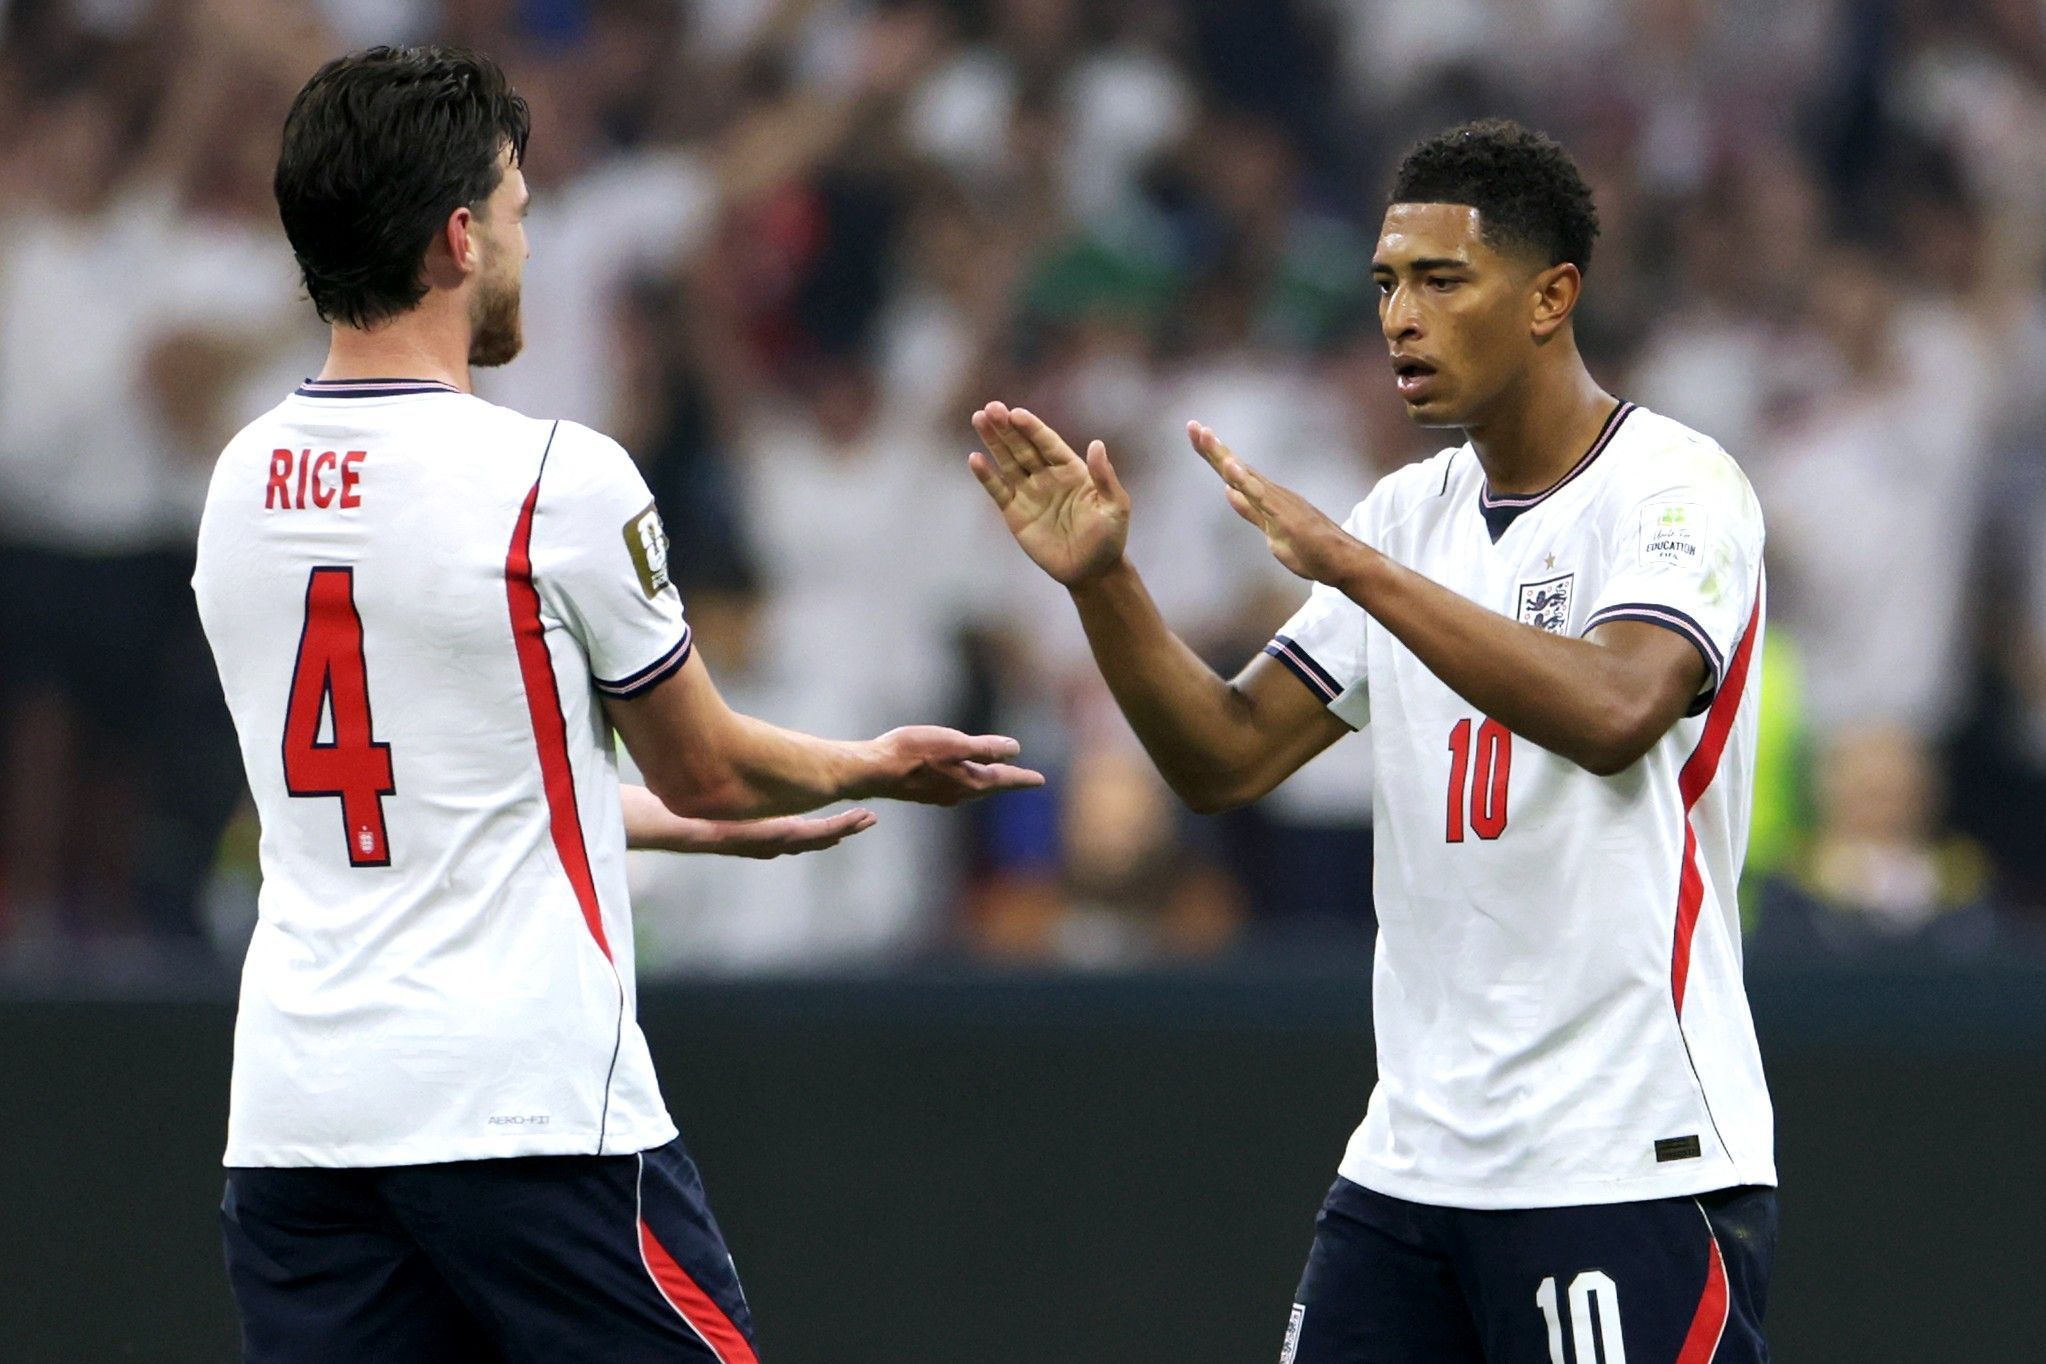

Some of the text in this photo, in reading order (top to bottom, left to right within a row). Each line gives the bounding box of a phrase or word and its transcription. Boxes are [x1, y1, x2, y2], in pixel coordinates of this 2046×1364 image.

[265, 448, 367, 510] RICE
[1646, 540, 1696, 556] EDUCATION
[281, 565, 396, 868] 4
[1446, 716, 1512, 843] 10
[488, 1115, 550, 1125] AERO-FIT
[1536, 1270, 1626, 1364] 10
